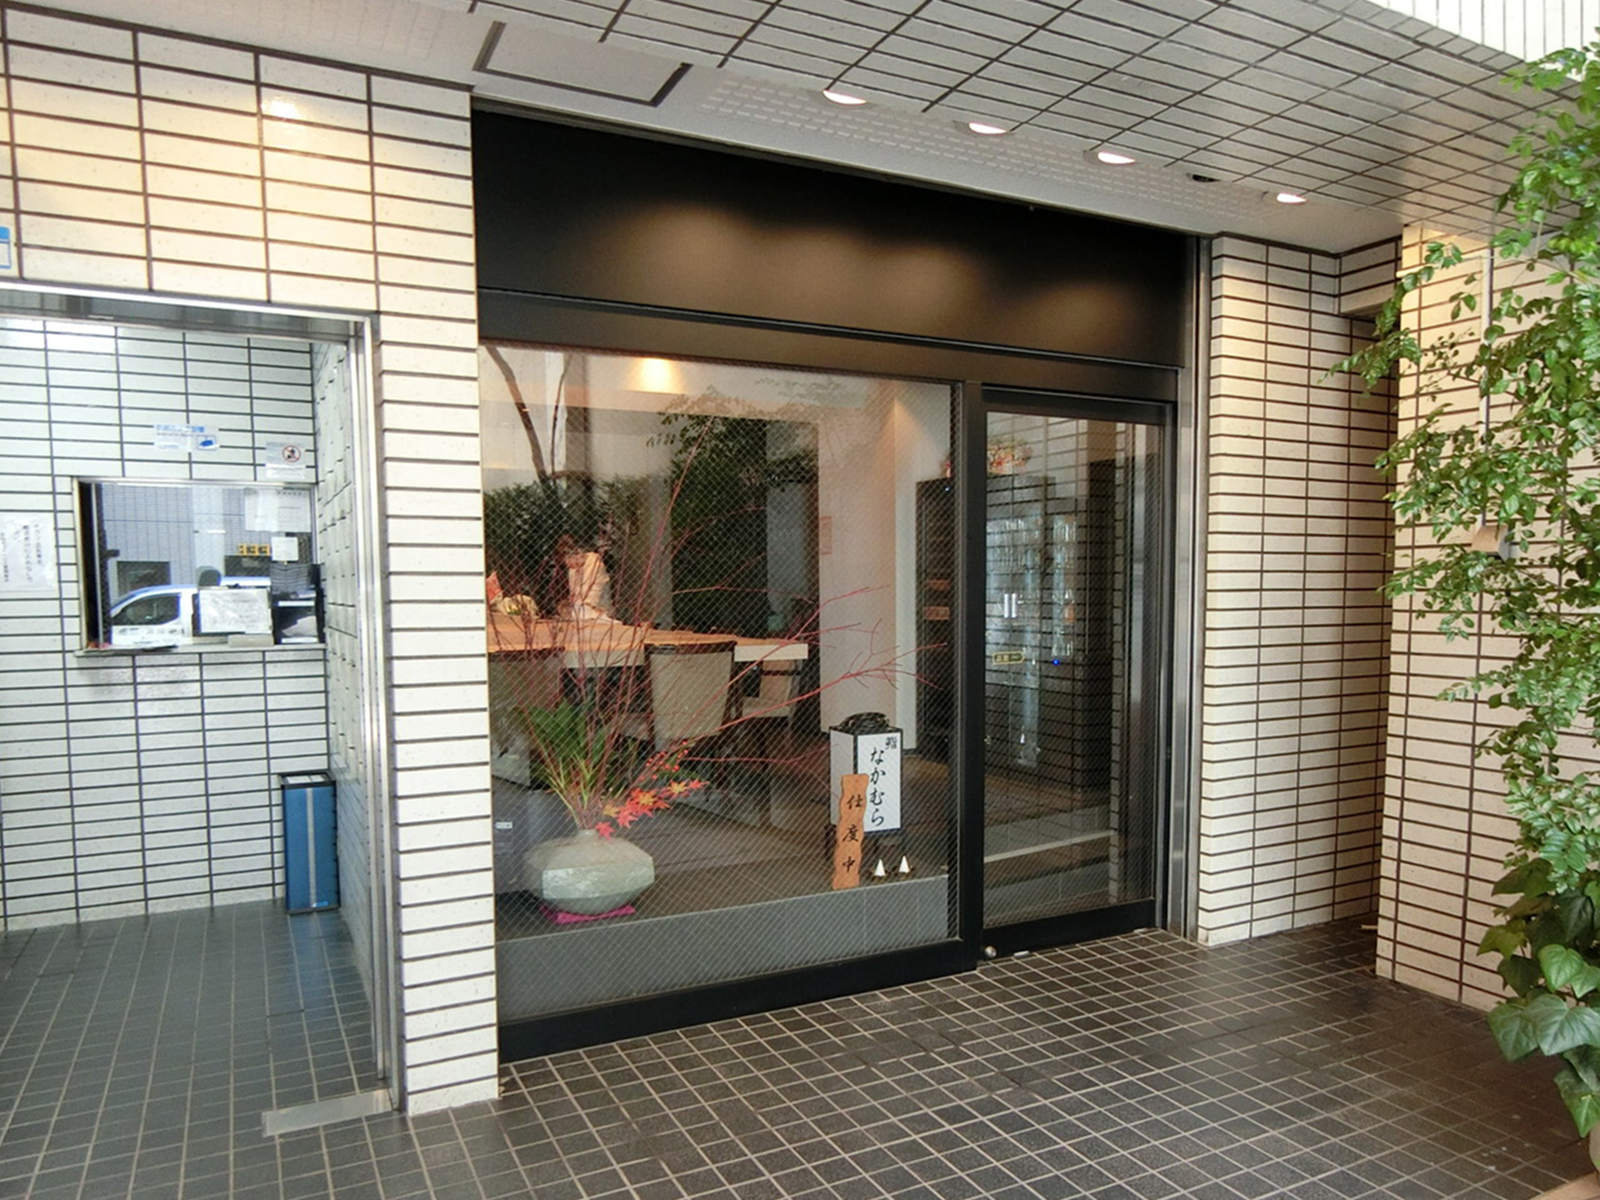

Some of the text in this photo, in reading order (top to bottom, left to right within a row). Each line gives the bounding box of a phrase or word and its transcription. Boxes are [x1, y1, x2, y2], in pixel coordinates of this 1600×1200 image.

[869, 747, 886, 827] なかむら
[841, 794, 864, 873] 仕度中
